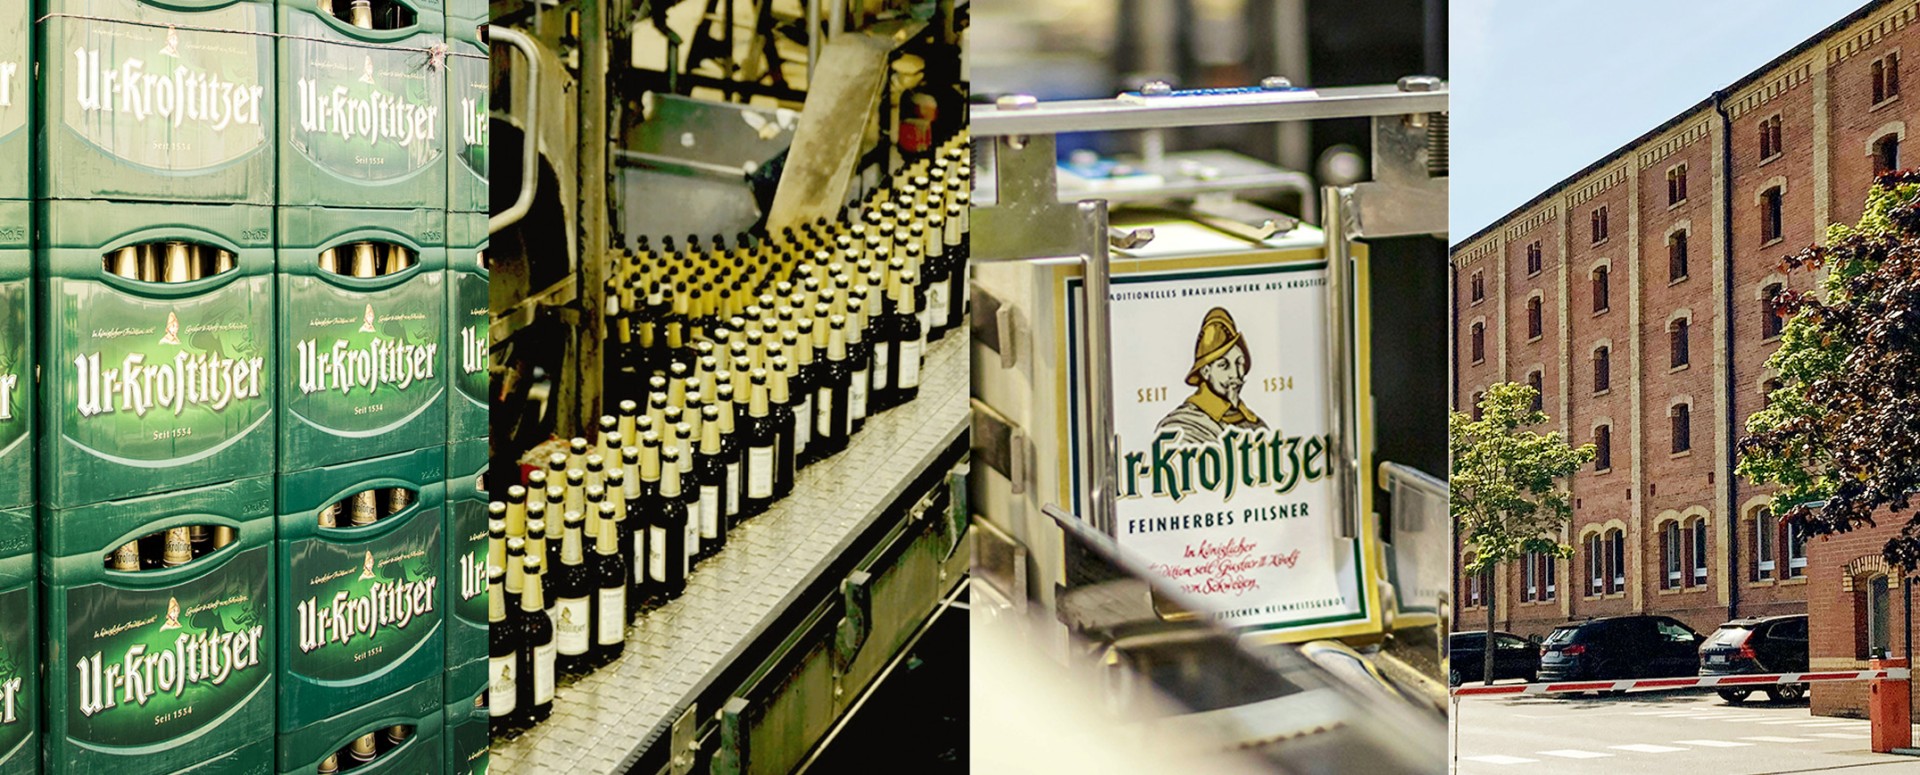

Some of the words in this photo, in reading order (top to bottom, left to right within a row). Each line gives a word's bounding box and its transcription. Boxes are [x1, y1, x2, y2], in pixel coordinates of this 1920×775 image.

[1110, 289, 1177, 301] ADITIONELLES
[1182, 282, 1260, 297] BRAUHANDWERK
[1265, 281, 1283, 291] AUS
[461, 325, 489, 374] Ur-
[1263, 375, 1294, 392] 1534
[1137, 386, 1168, 403] SEIT
[354, 406, 367, 415] Seit
[368, 404, 384, 413] 1534
[153, 430, 170, 441] Seit
[172, 427, 192, 438] 1534
[1129, 510, 1234, 535] FEINHERBES
[1244, 502, 1309, 524] PILSNER
[354, 653, 367, 663] Seit
[154, 714, 171, 726] Seit
[173, 706, 193, 719] 1534
